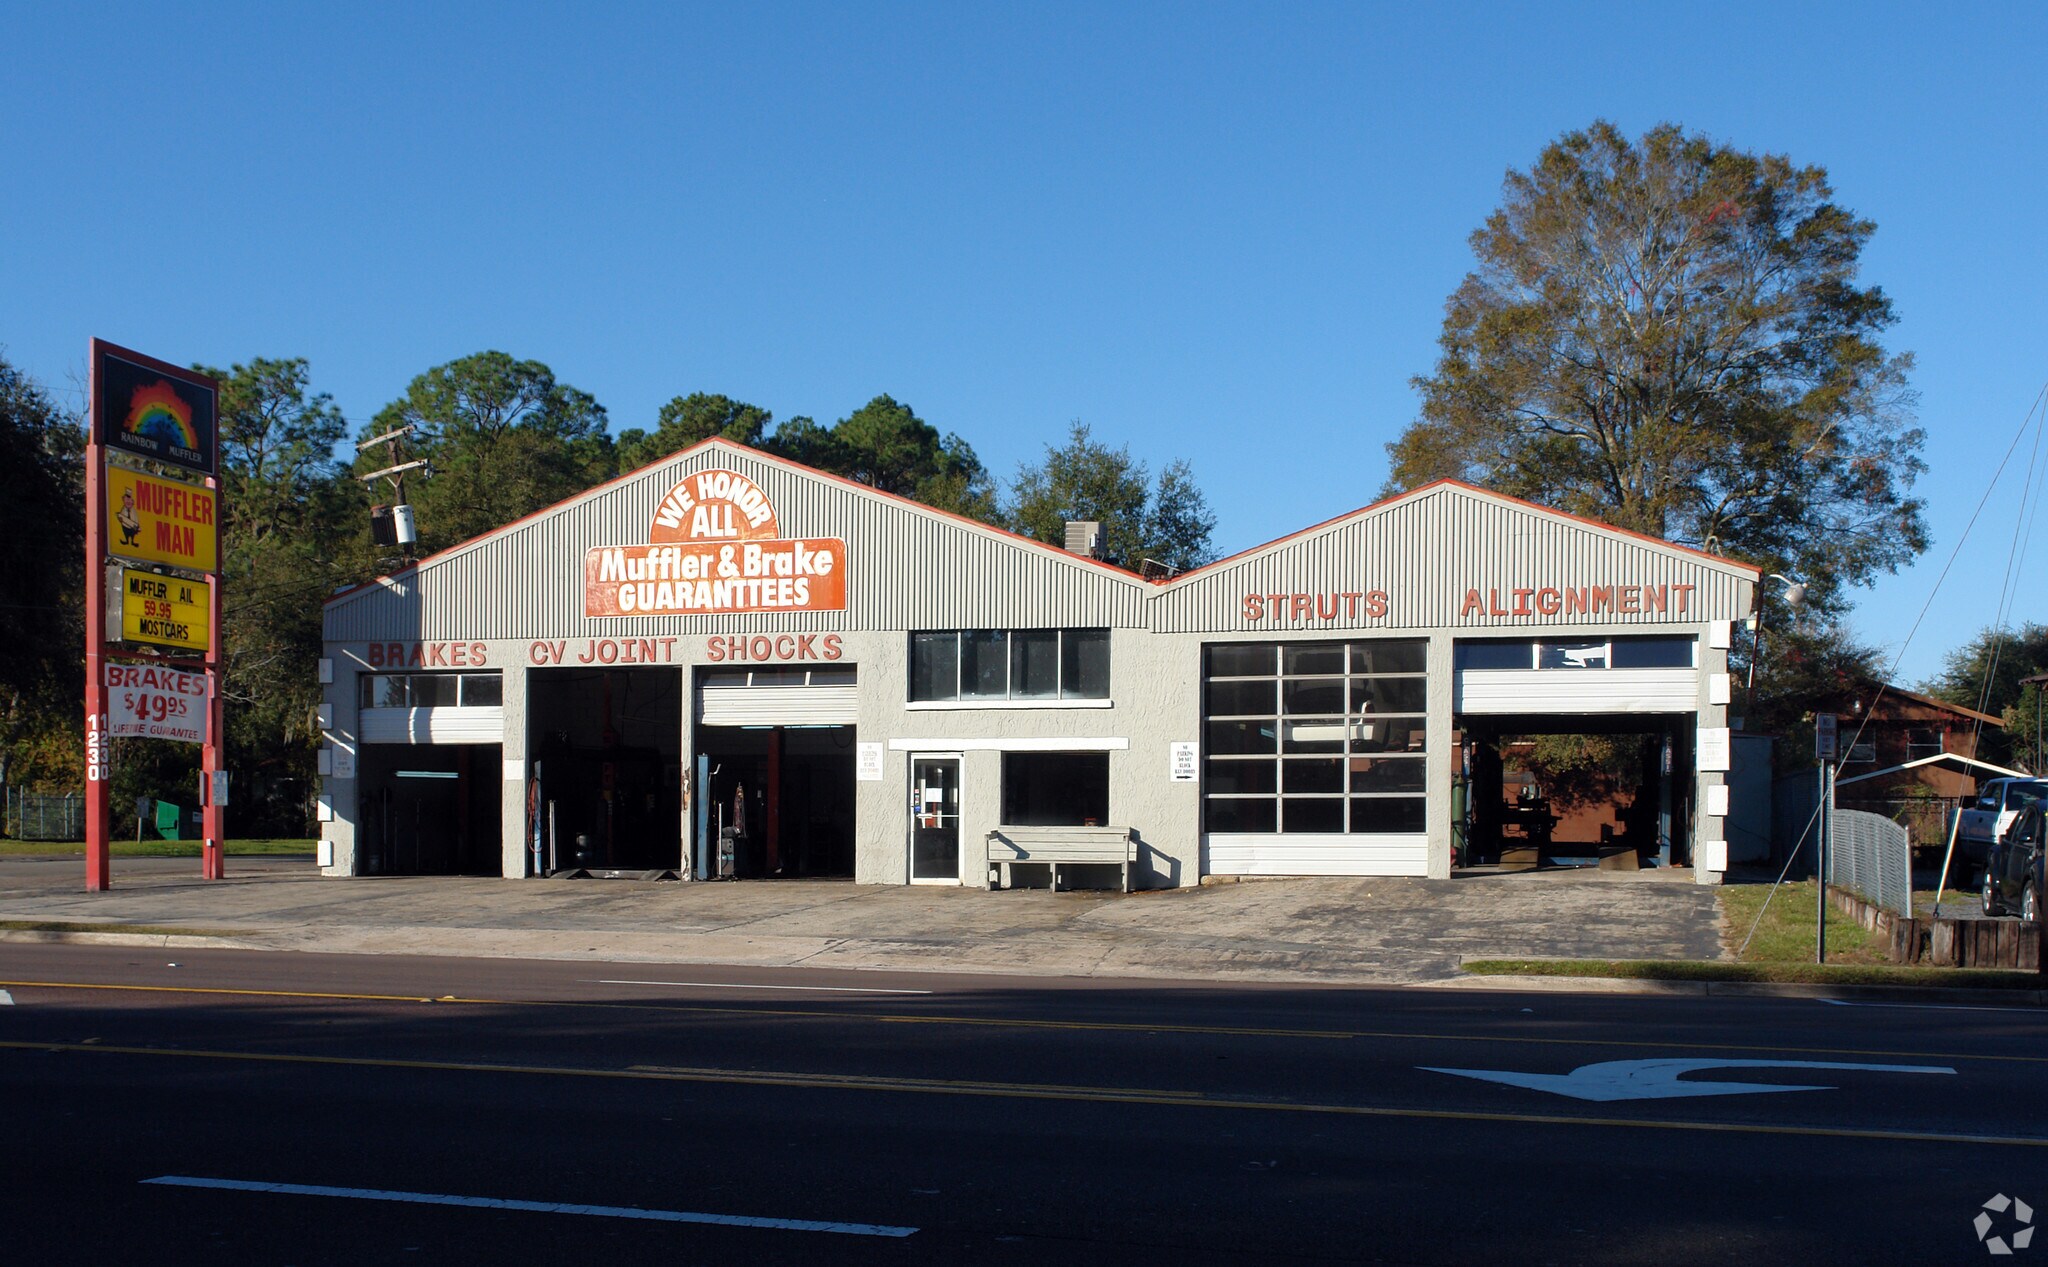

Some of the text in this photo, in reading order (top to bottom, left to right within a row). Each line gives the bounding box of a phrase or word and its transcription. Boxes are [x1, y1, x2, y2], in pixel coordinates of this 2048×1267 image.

[121, 431, 202, 462] RAINBOW MUFFLER
[136, 480, 213, 526] MUFFLER
[656, 472, 772, 529] WE HONOR
[690, 504, 738, 538] ALL
[156, 521, 195, 557] MAN
[600, 541, 834, 582] Muffler & Brake
[130, 577, 167, 600] MUFFLER
[1461, 584, 1695, 617] ALIGNMENT
[144, 600, 172, 619] 59.95
[1244, 590, 1388, 621] STRUTS
[368, 642, 488, 667] BRAKES
[529, 637, 678, 665] CV JOINT
[707, 634, 842, 661] SHOCKS
[108, 666, 205, 696] BRAKES
[87, 713, 100, 781] 1230
